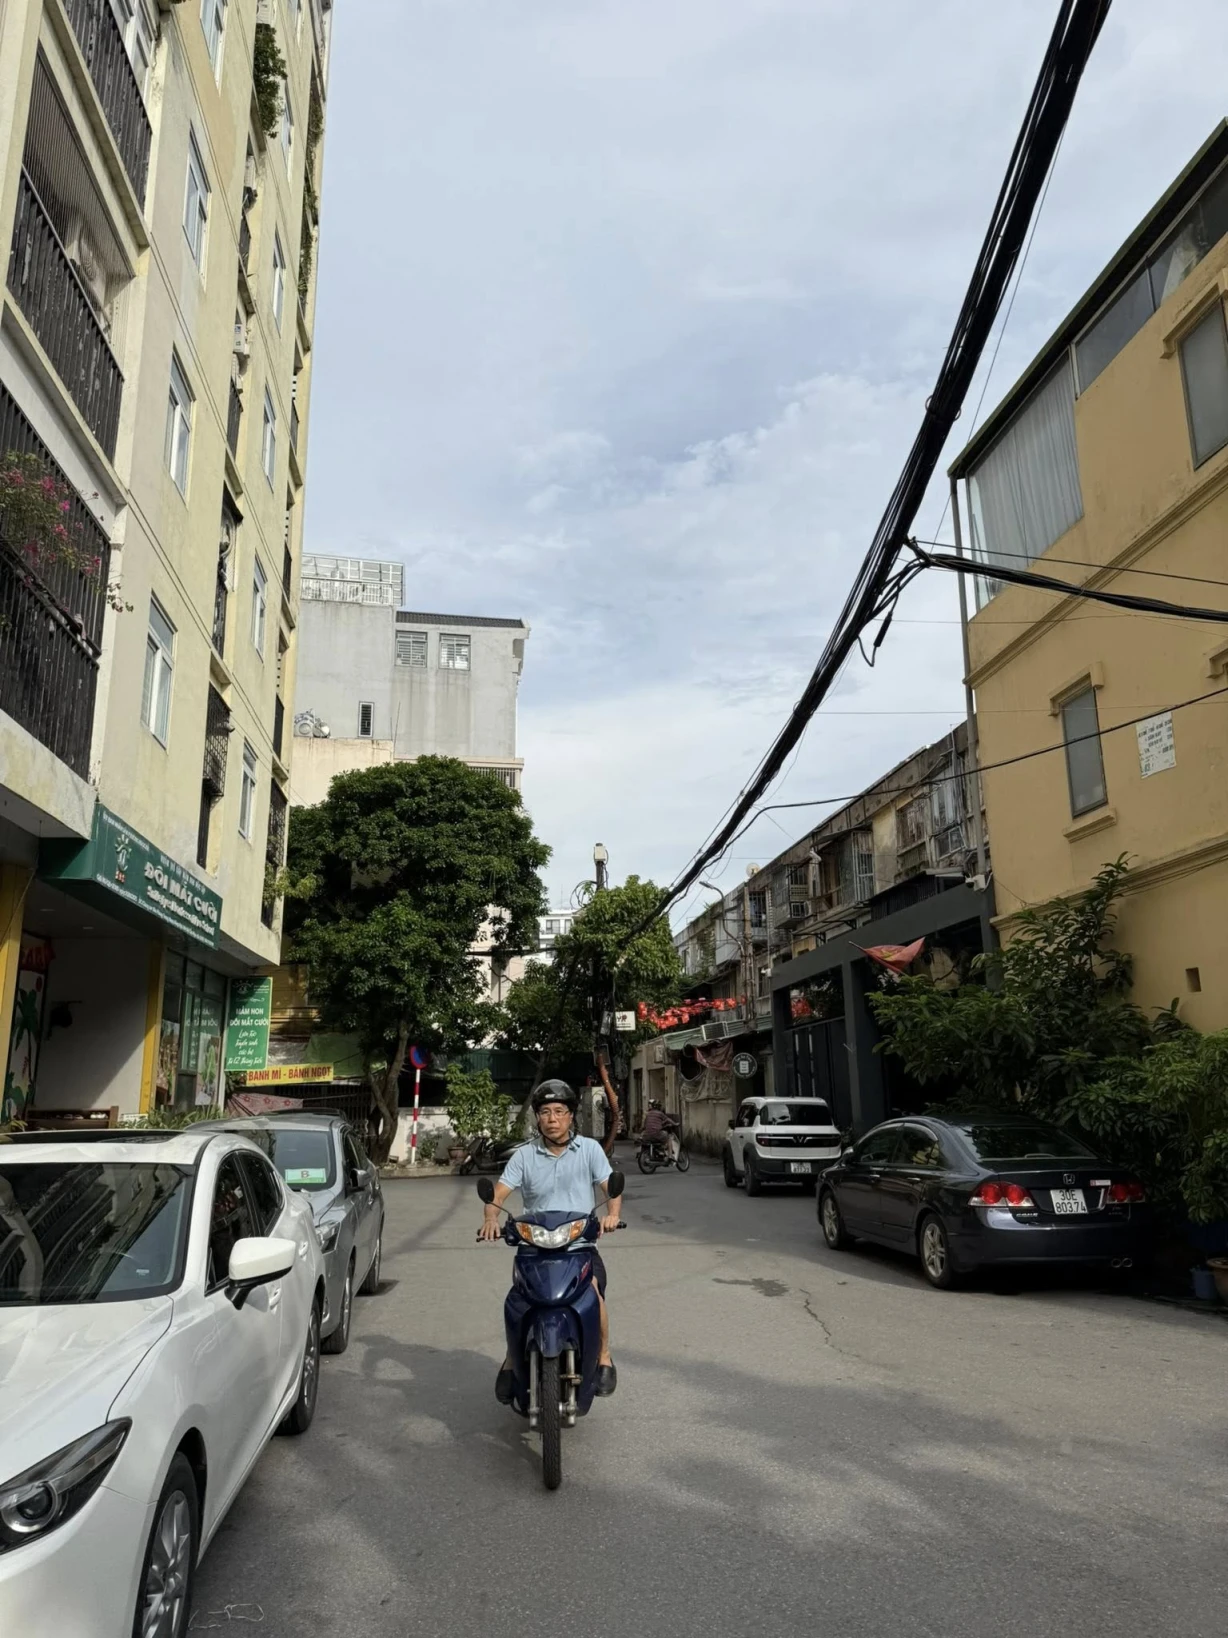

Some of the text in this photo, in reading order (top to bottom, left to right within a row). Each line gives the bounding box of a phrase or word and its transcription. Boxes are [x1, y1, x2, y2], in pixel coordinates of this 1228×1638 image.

[144, 861, 168, 889] ĐÔI
[241, 1016, 253, 1026] MẮT
[271, 1066, 281, 1080] MÌ
[288, 1066, 308, 1079] BÁNH
[310, 1066, 331, 1079] NGỌT
[301, 1170, 309, 1179] B
[1059, 1190, 1078, 1201] 30E
[1055, 1201, 1087, 1214] 803.74
